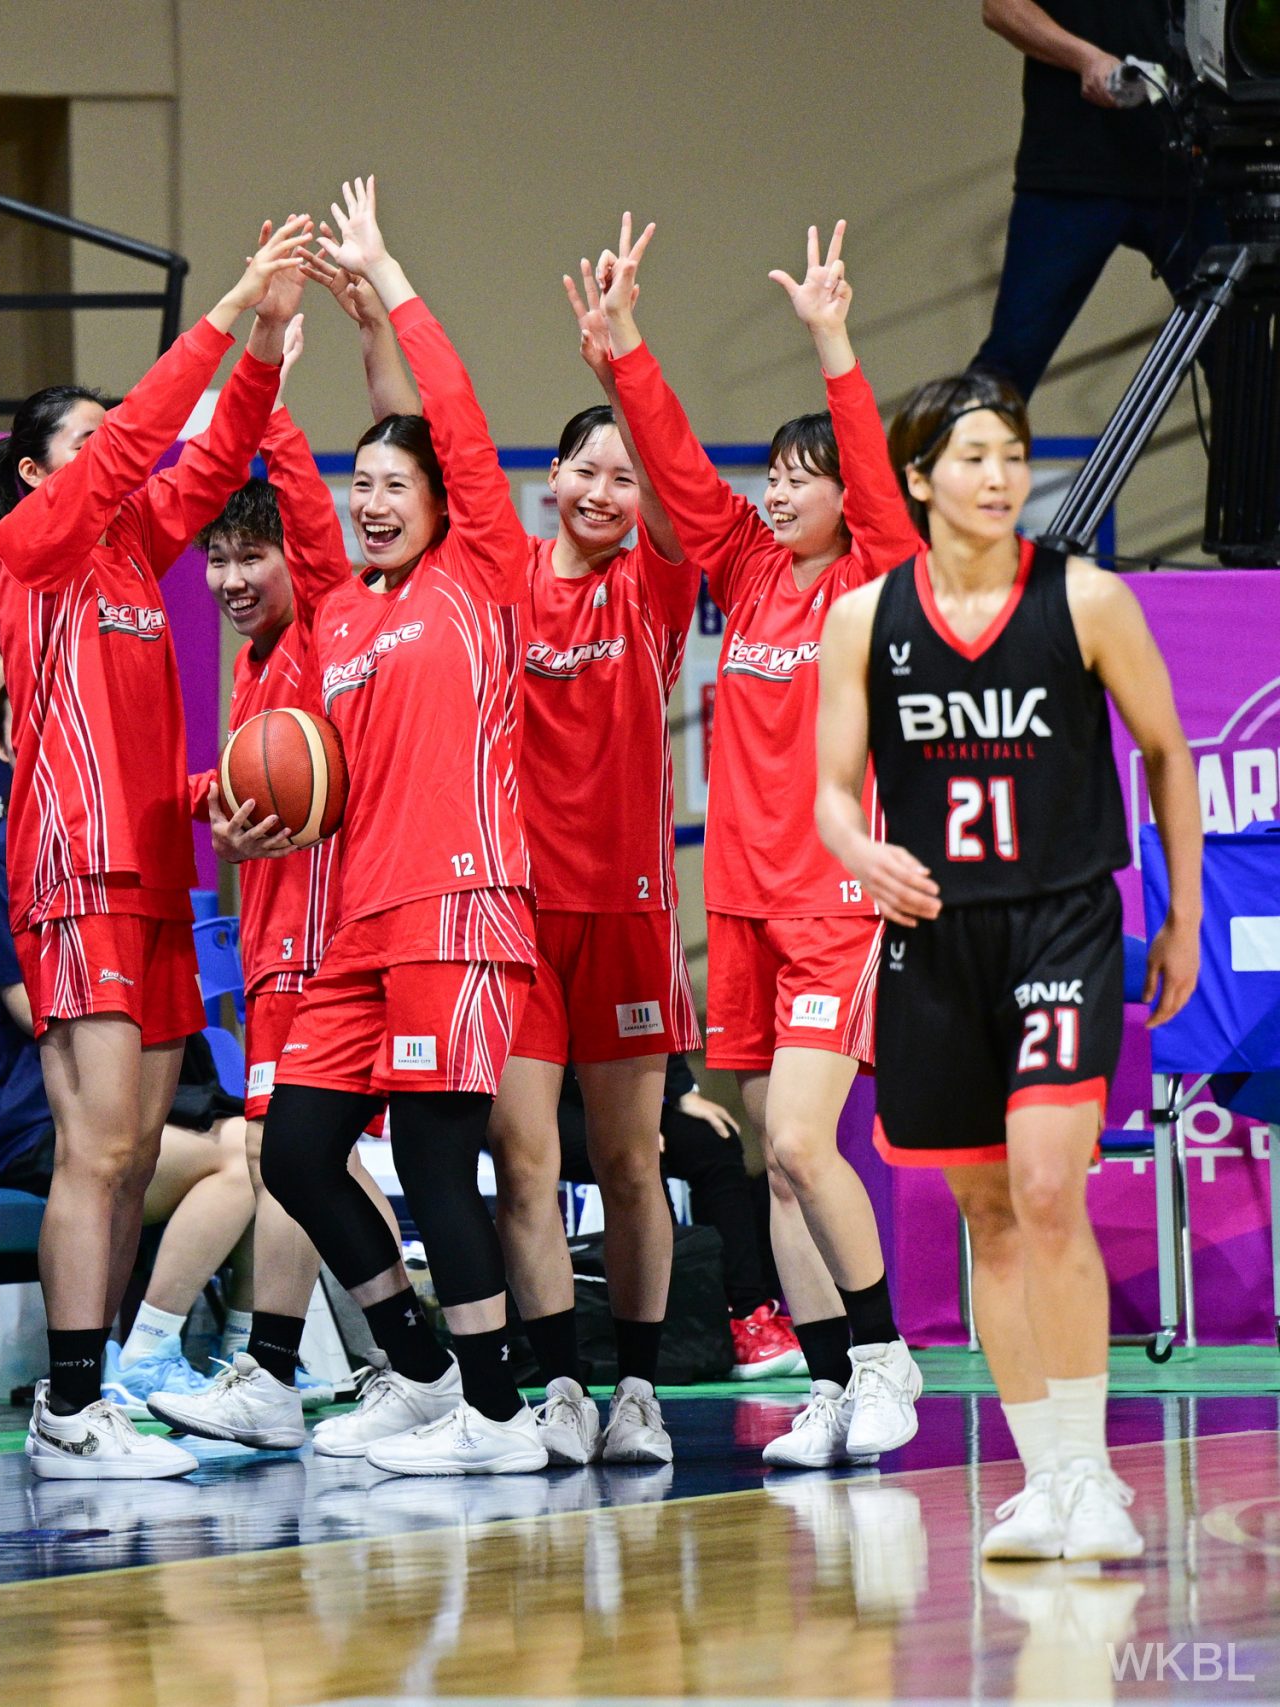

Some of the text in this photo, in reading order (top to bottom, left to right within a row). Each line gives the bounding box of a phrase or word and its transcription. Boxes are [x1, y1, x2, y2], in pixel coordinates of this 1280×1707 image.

[897, 687, 1053, 742] BNK
[923, 743, 1036, 761] BASKETBALL
[1198, 747, 1280, 835] AR
[946, 775, 1019, 862] 21
[451, 852, 476, 878] 12
[637, 876, 649, 899] 2
[839, 880, 862, 903] 13
[282, 937, 293, 960] 3
[1014, 979, 1084, 1010] BNK
[1017, 1007, 1079, 1074] 21
